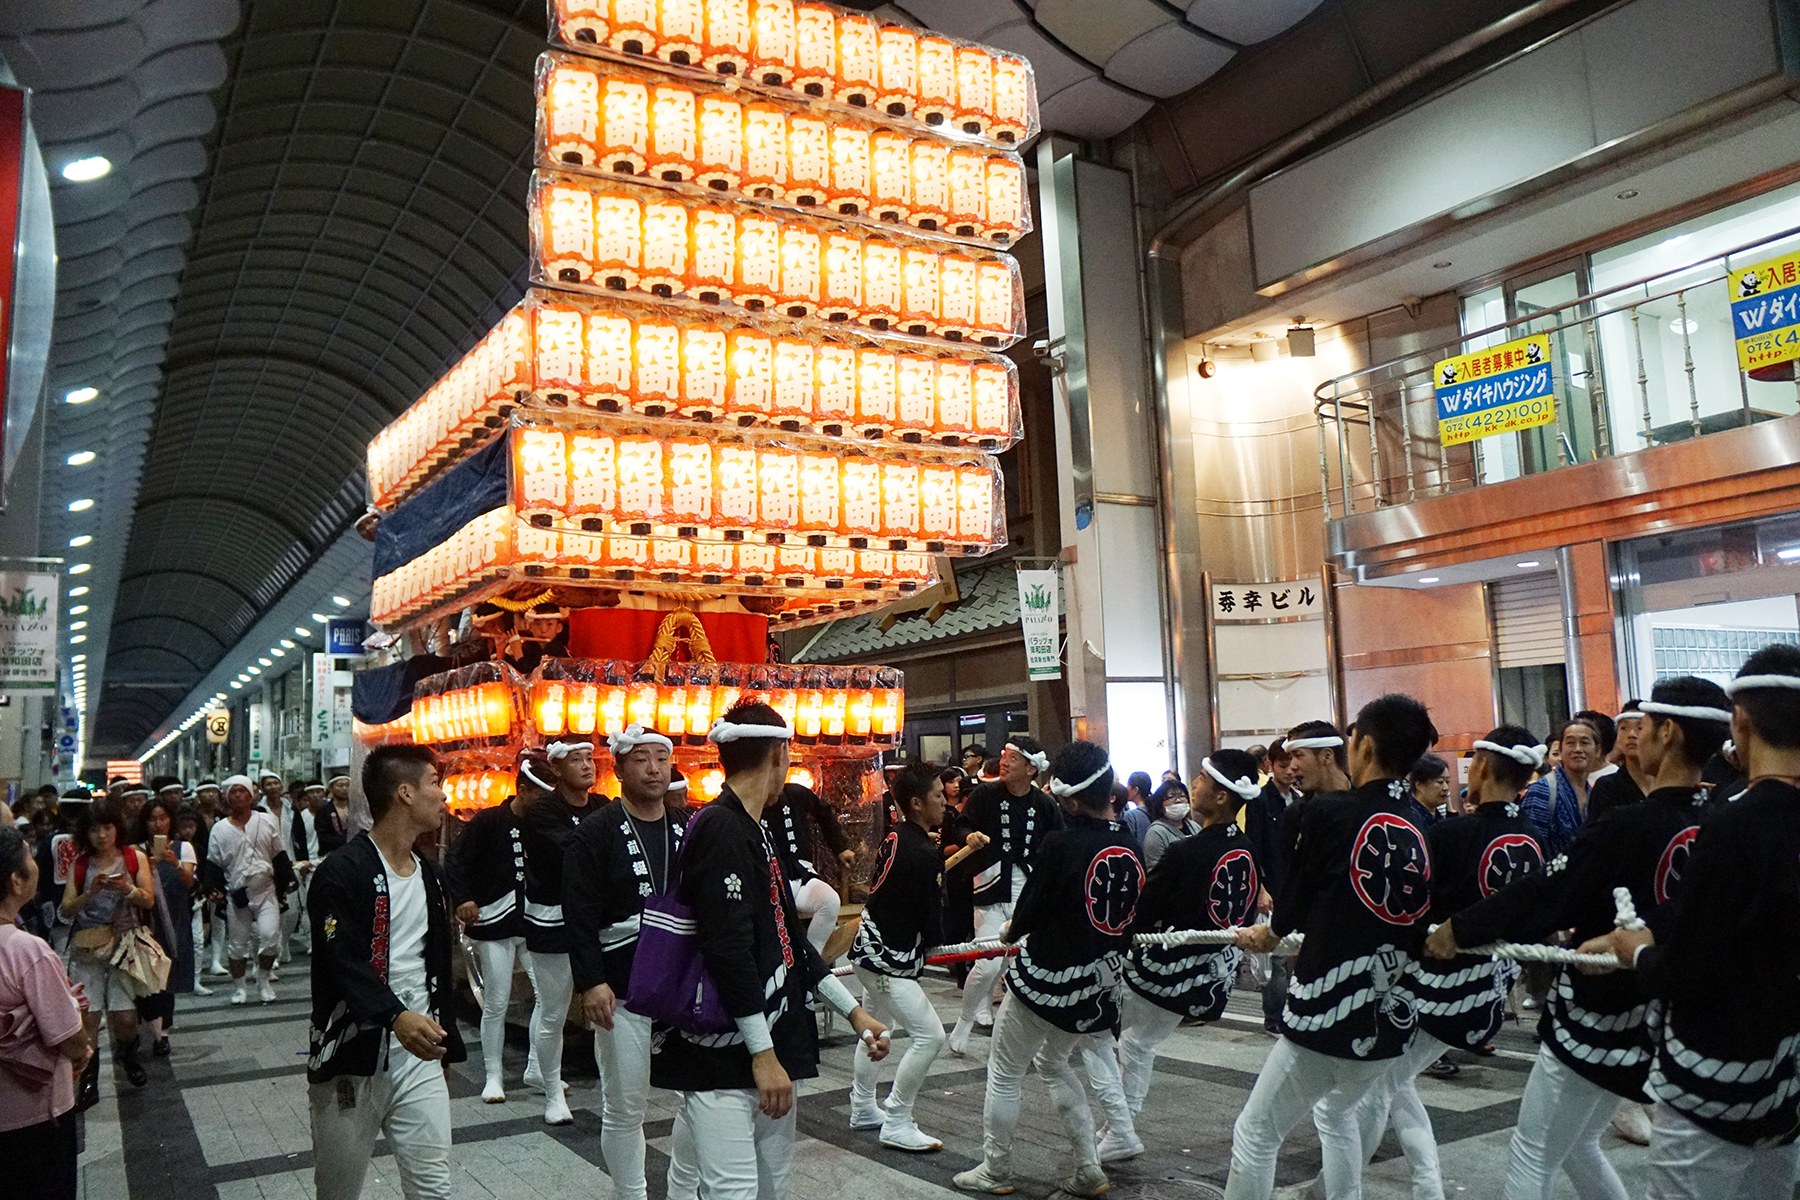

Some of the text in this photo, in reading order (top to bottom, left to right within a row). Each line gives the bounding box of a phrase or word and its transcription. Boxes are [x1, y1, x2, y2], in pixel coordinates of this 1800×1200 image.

[1461, 348, 1524, 380] 入居者募集中
[1218, 586, 1316, 614] 秀幸ビル
[334, 628, 360, 643] PARIS
